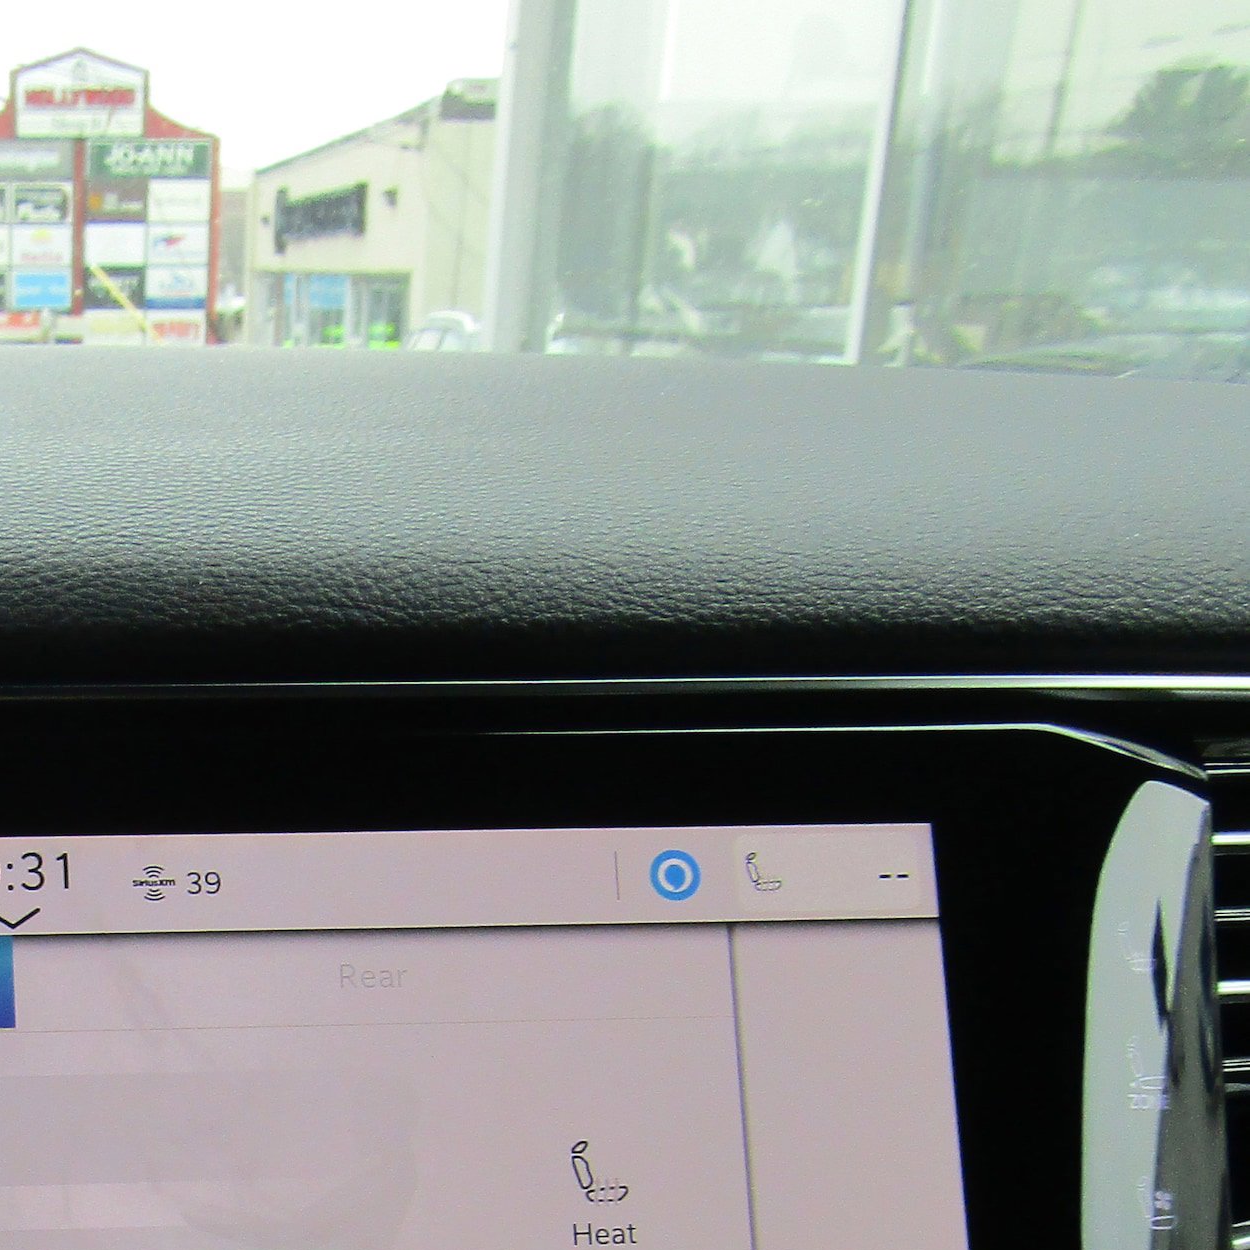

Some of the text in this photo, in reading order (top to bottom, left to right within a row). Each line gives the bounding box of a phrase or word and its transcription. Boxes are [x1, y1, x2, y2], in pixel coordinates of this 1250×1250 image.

[186, 871, 222, 895] 39
[339, 963, 408, 989] Rear
[572, 1223, 638, 1246] Heat
